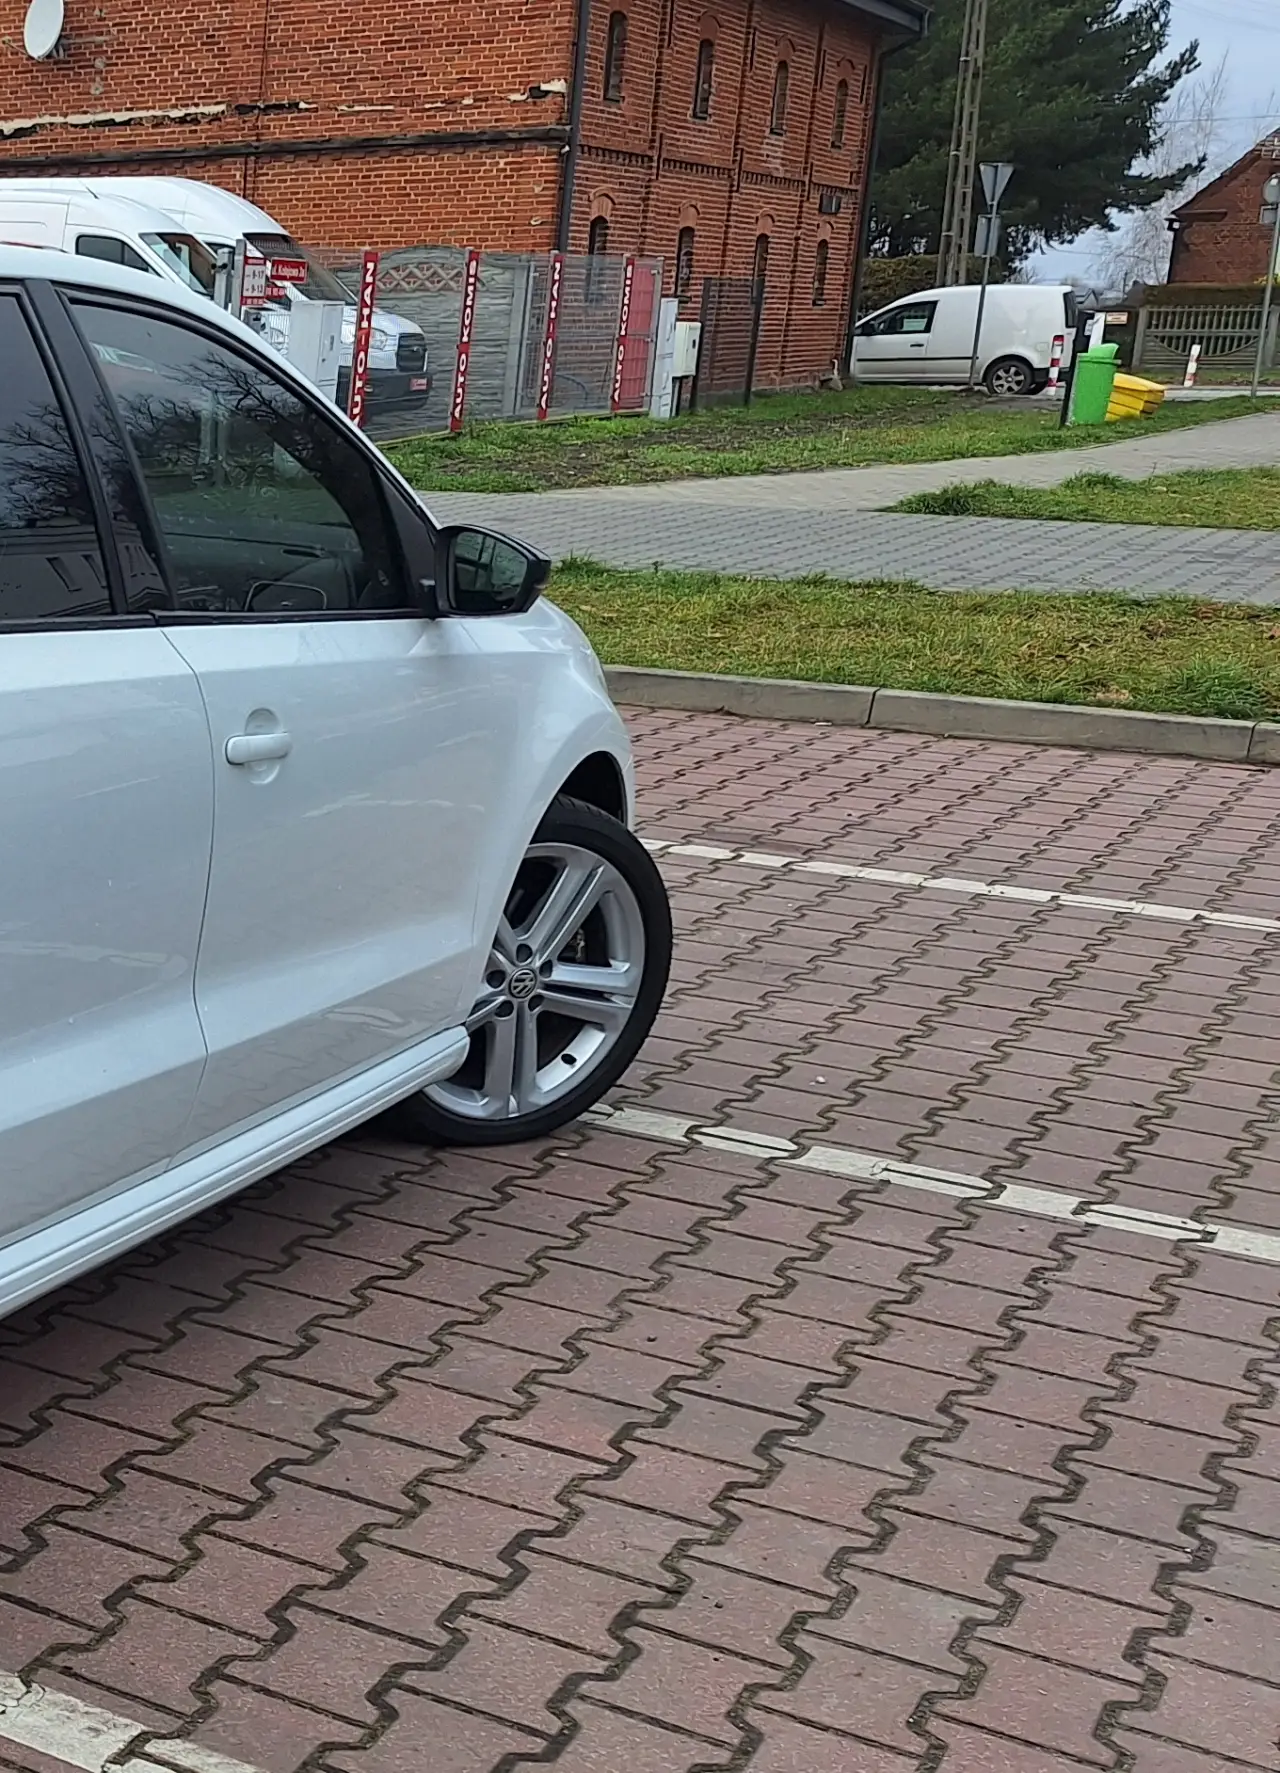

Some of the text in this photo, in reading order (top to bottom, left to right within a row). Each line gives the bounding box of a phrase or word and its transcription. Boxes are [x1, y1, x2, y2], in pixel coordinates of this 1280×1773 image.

[360, 262, 376, 329] HAN
[454, 259, 477, 420] AUTO KOMIS
[541, 337, 554, 411] AUTO
[549, 261, 561, 319] HAN
[613, 264, 633, 403] AUTO KOMIS
